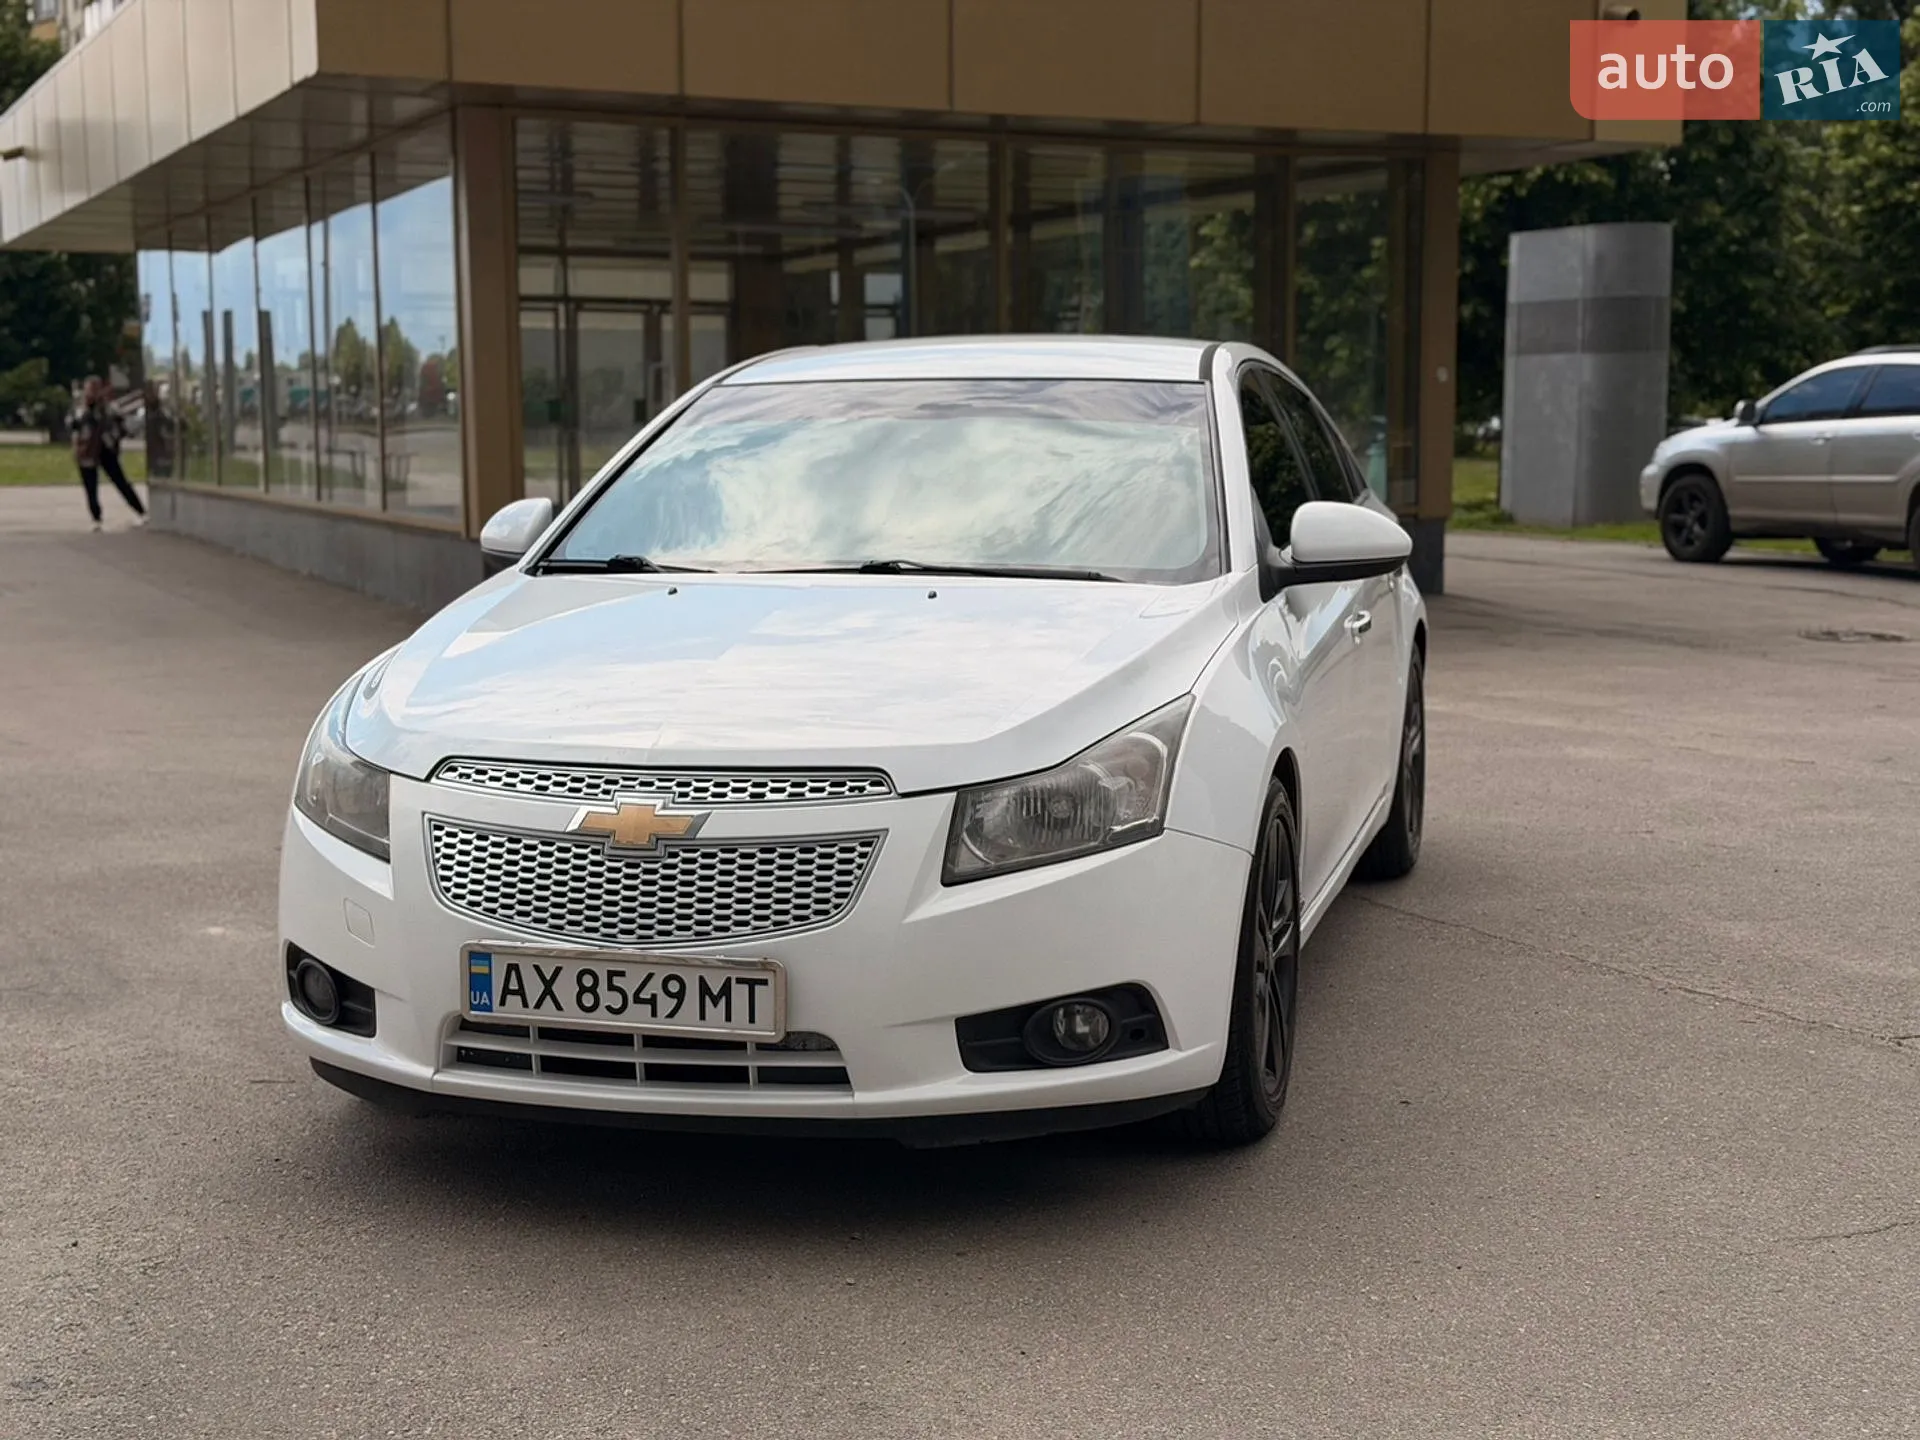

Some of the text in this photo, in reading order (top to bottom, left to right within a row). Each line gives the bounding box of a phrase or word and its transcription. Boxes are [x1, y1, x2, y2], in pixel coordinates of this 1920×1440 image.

[470, 991, 491, 1006] UA
[499, 963, 769, 1024] AX 8549 MT
